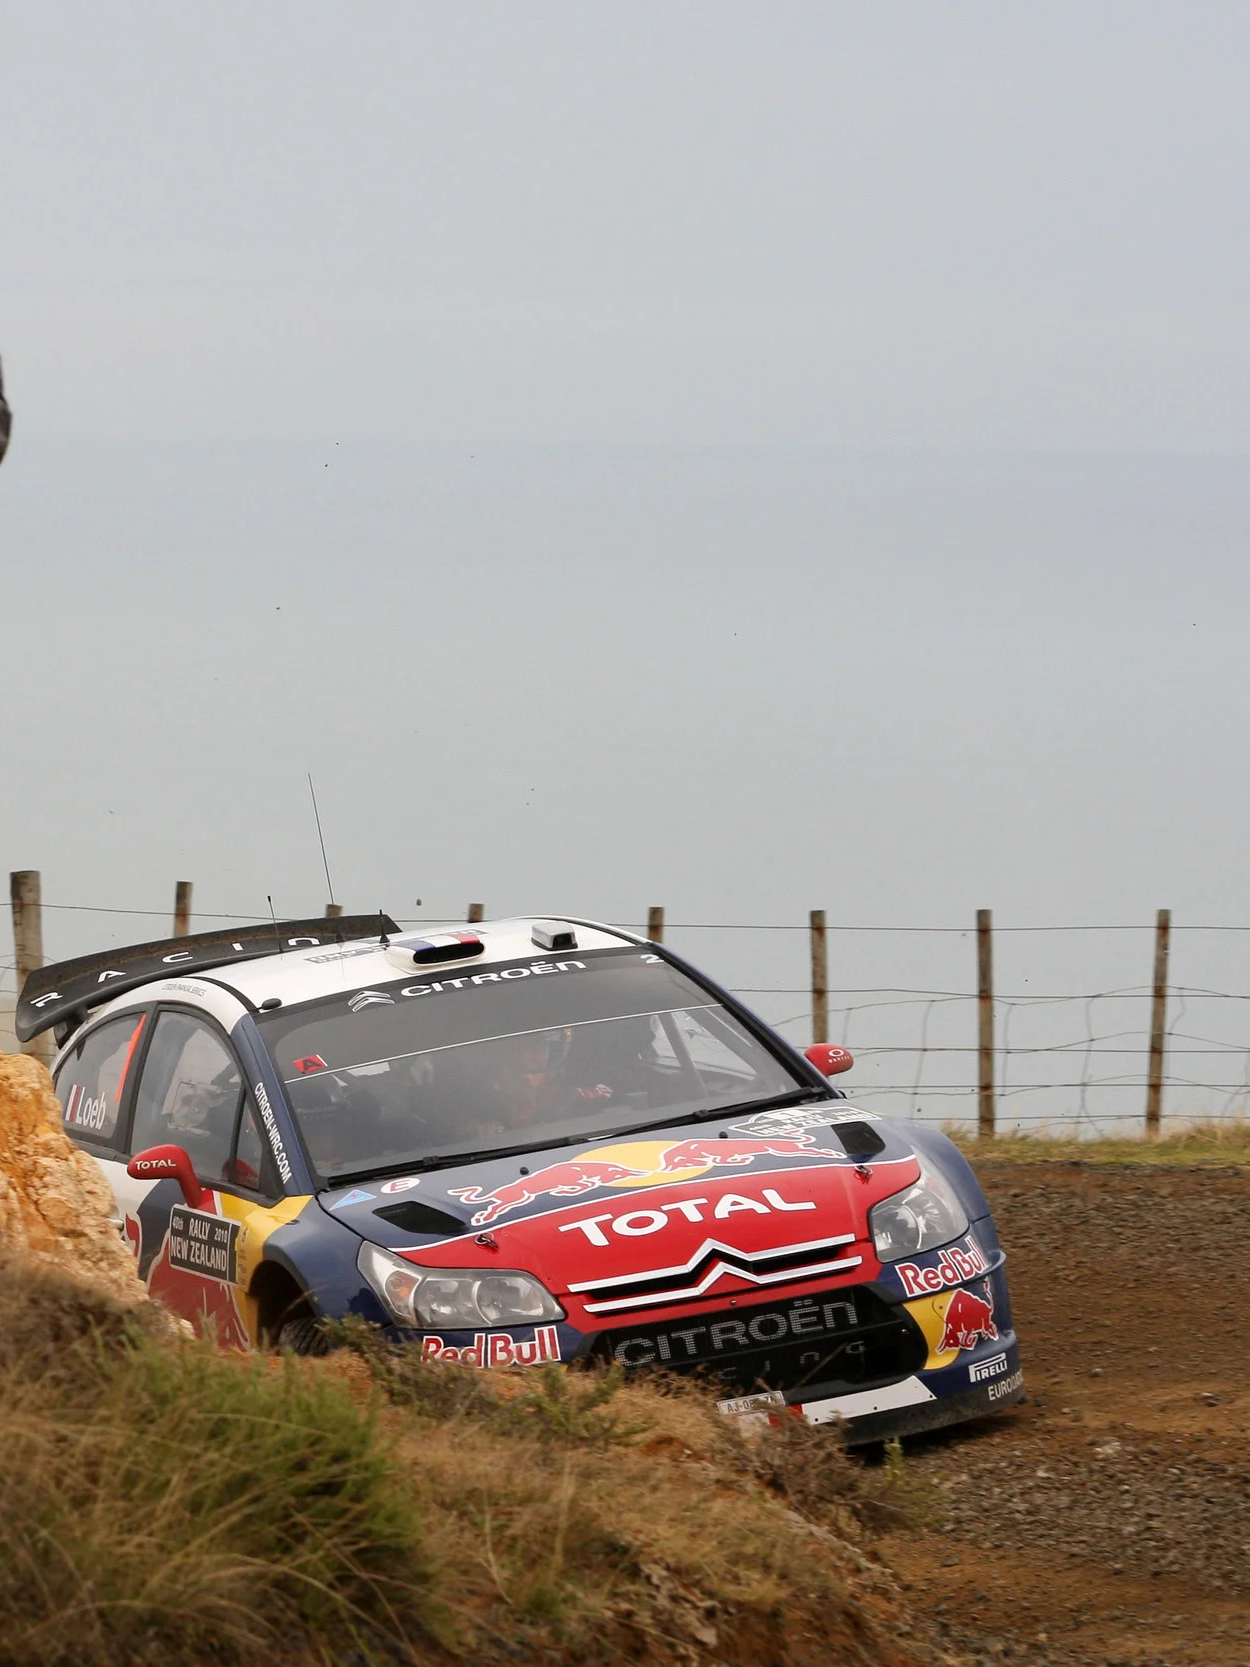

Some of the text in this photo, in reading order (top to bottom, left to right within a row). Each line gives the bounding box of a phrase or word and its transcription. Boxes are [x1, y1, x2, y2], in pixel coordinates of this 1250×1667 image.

[75, 1086, 107, 1130] Loeb
[254, 1081, 292, 1185] CITROEN-WRC.COM
[135, 1159, 177, 1171] TOTAL
[188, 1218, 211, 1241] RALLY
[214, 1228, 228, 1243] 2010
[559, 1188, 817, 1247] TOTAL
[170, 1235, 189, 1260] NEW
[190, 1240, 227, 1272] ZEALAND
[895, 1235, 990, 1297] Red Bull
[421, 1325, 561, 1369] Red Bull
[968, 1352, 1008, 1383] PIRELLI
